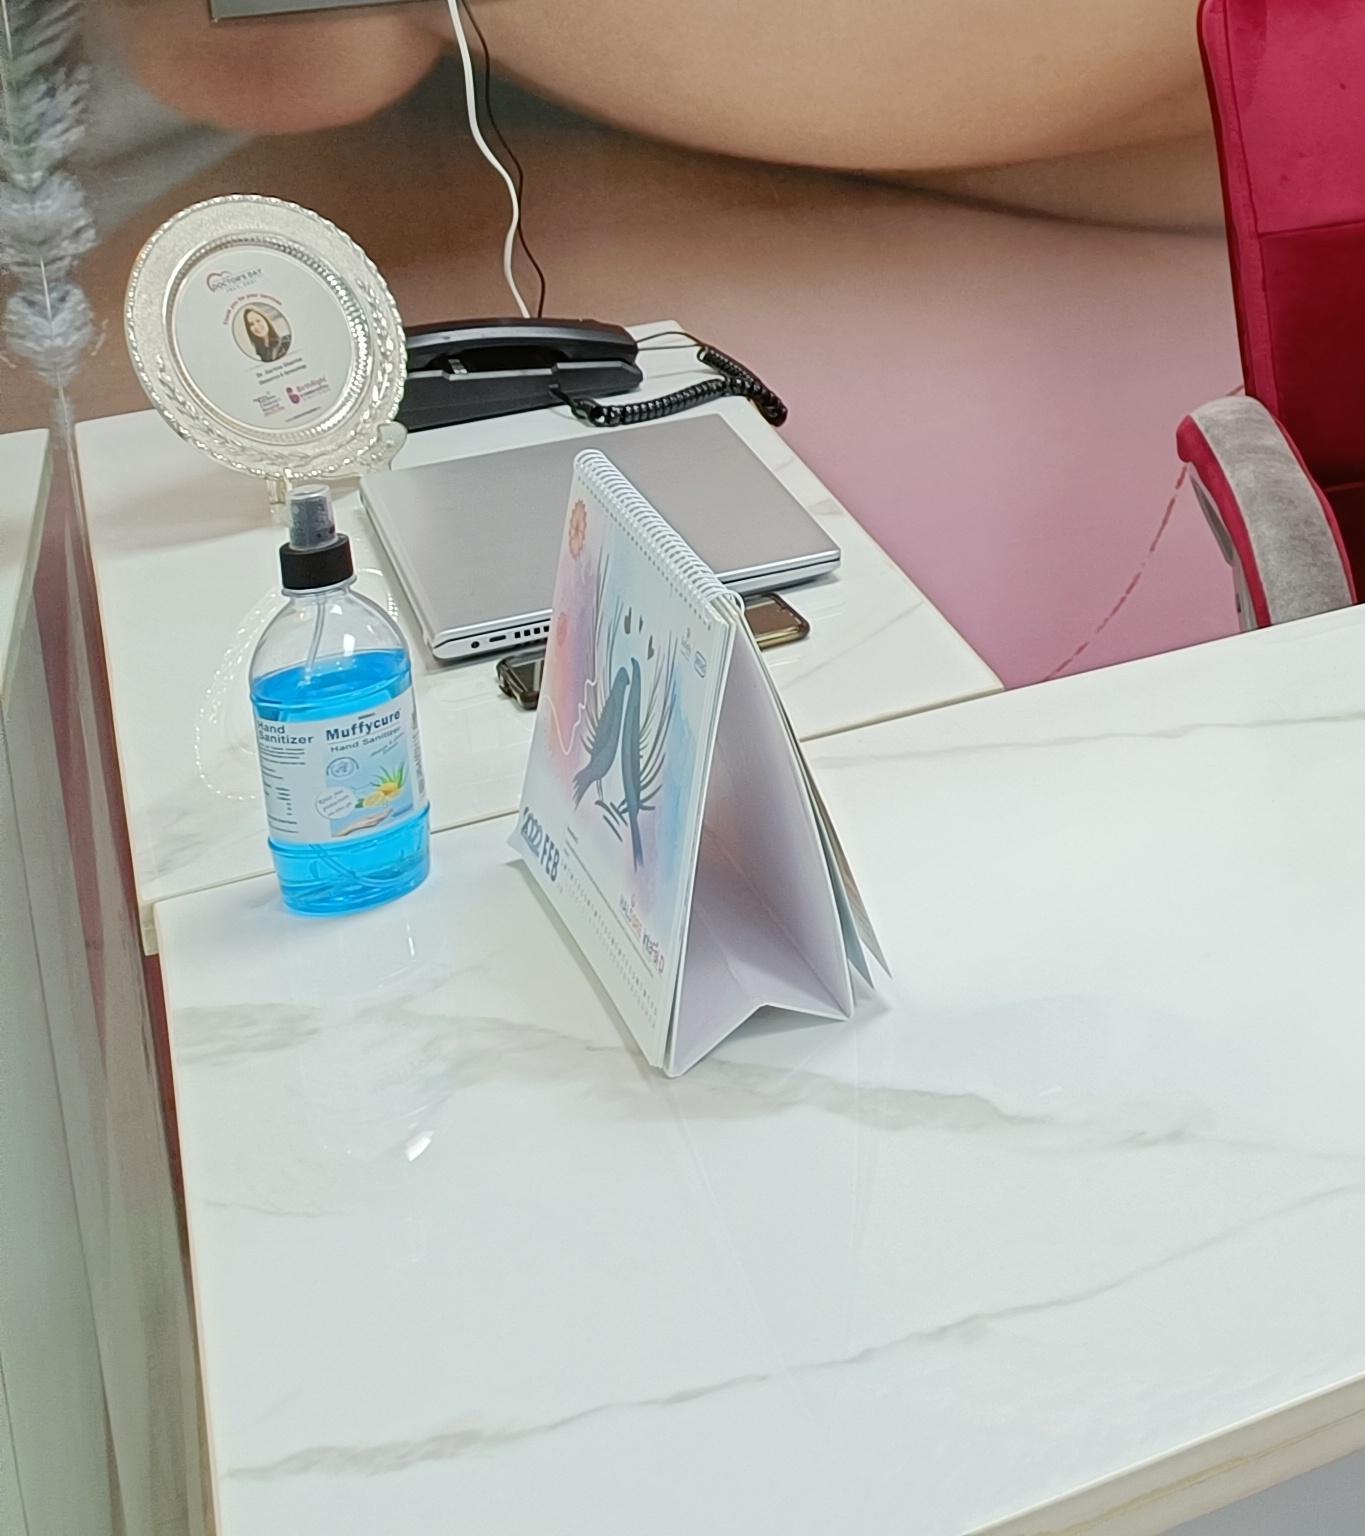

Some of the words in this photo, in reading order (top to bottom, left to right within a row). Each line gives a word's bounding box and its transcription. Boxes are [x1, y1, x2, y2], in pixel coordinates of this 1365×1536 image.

[257, 721, 286, 734] Hand
[326, 709, 400, 741] Muffycure
[258, 730, 314, 744] Sanitizer
[540, 834, 560, 882] FEB
